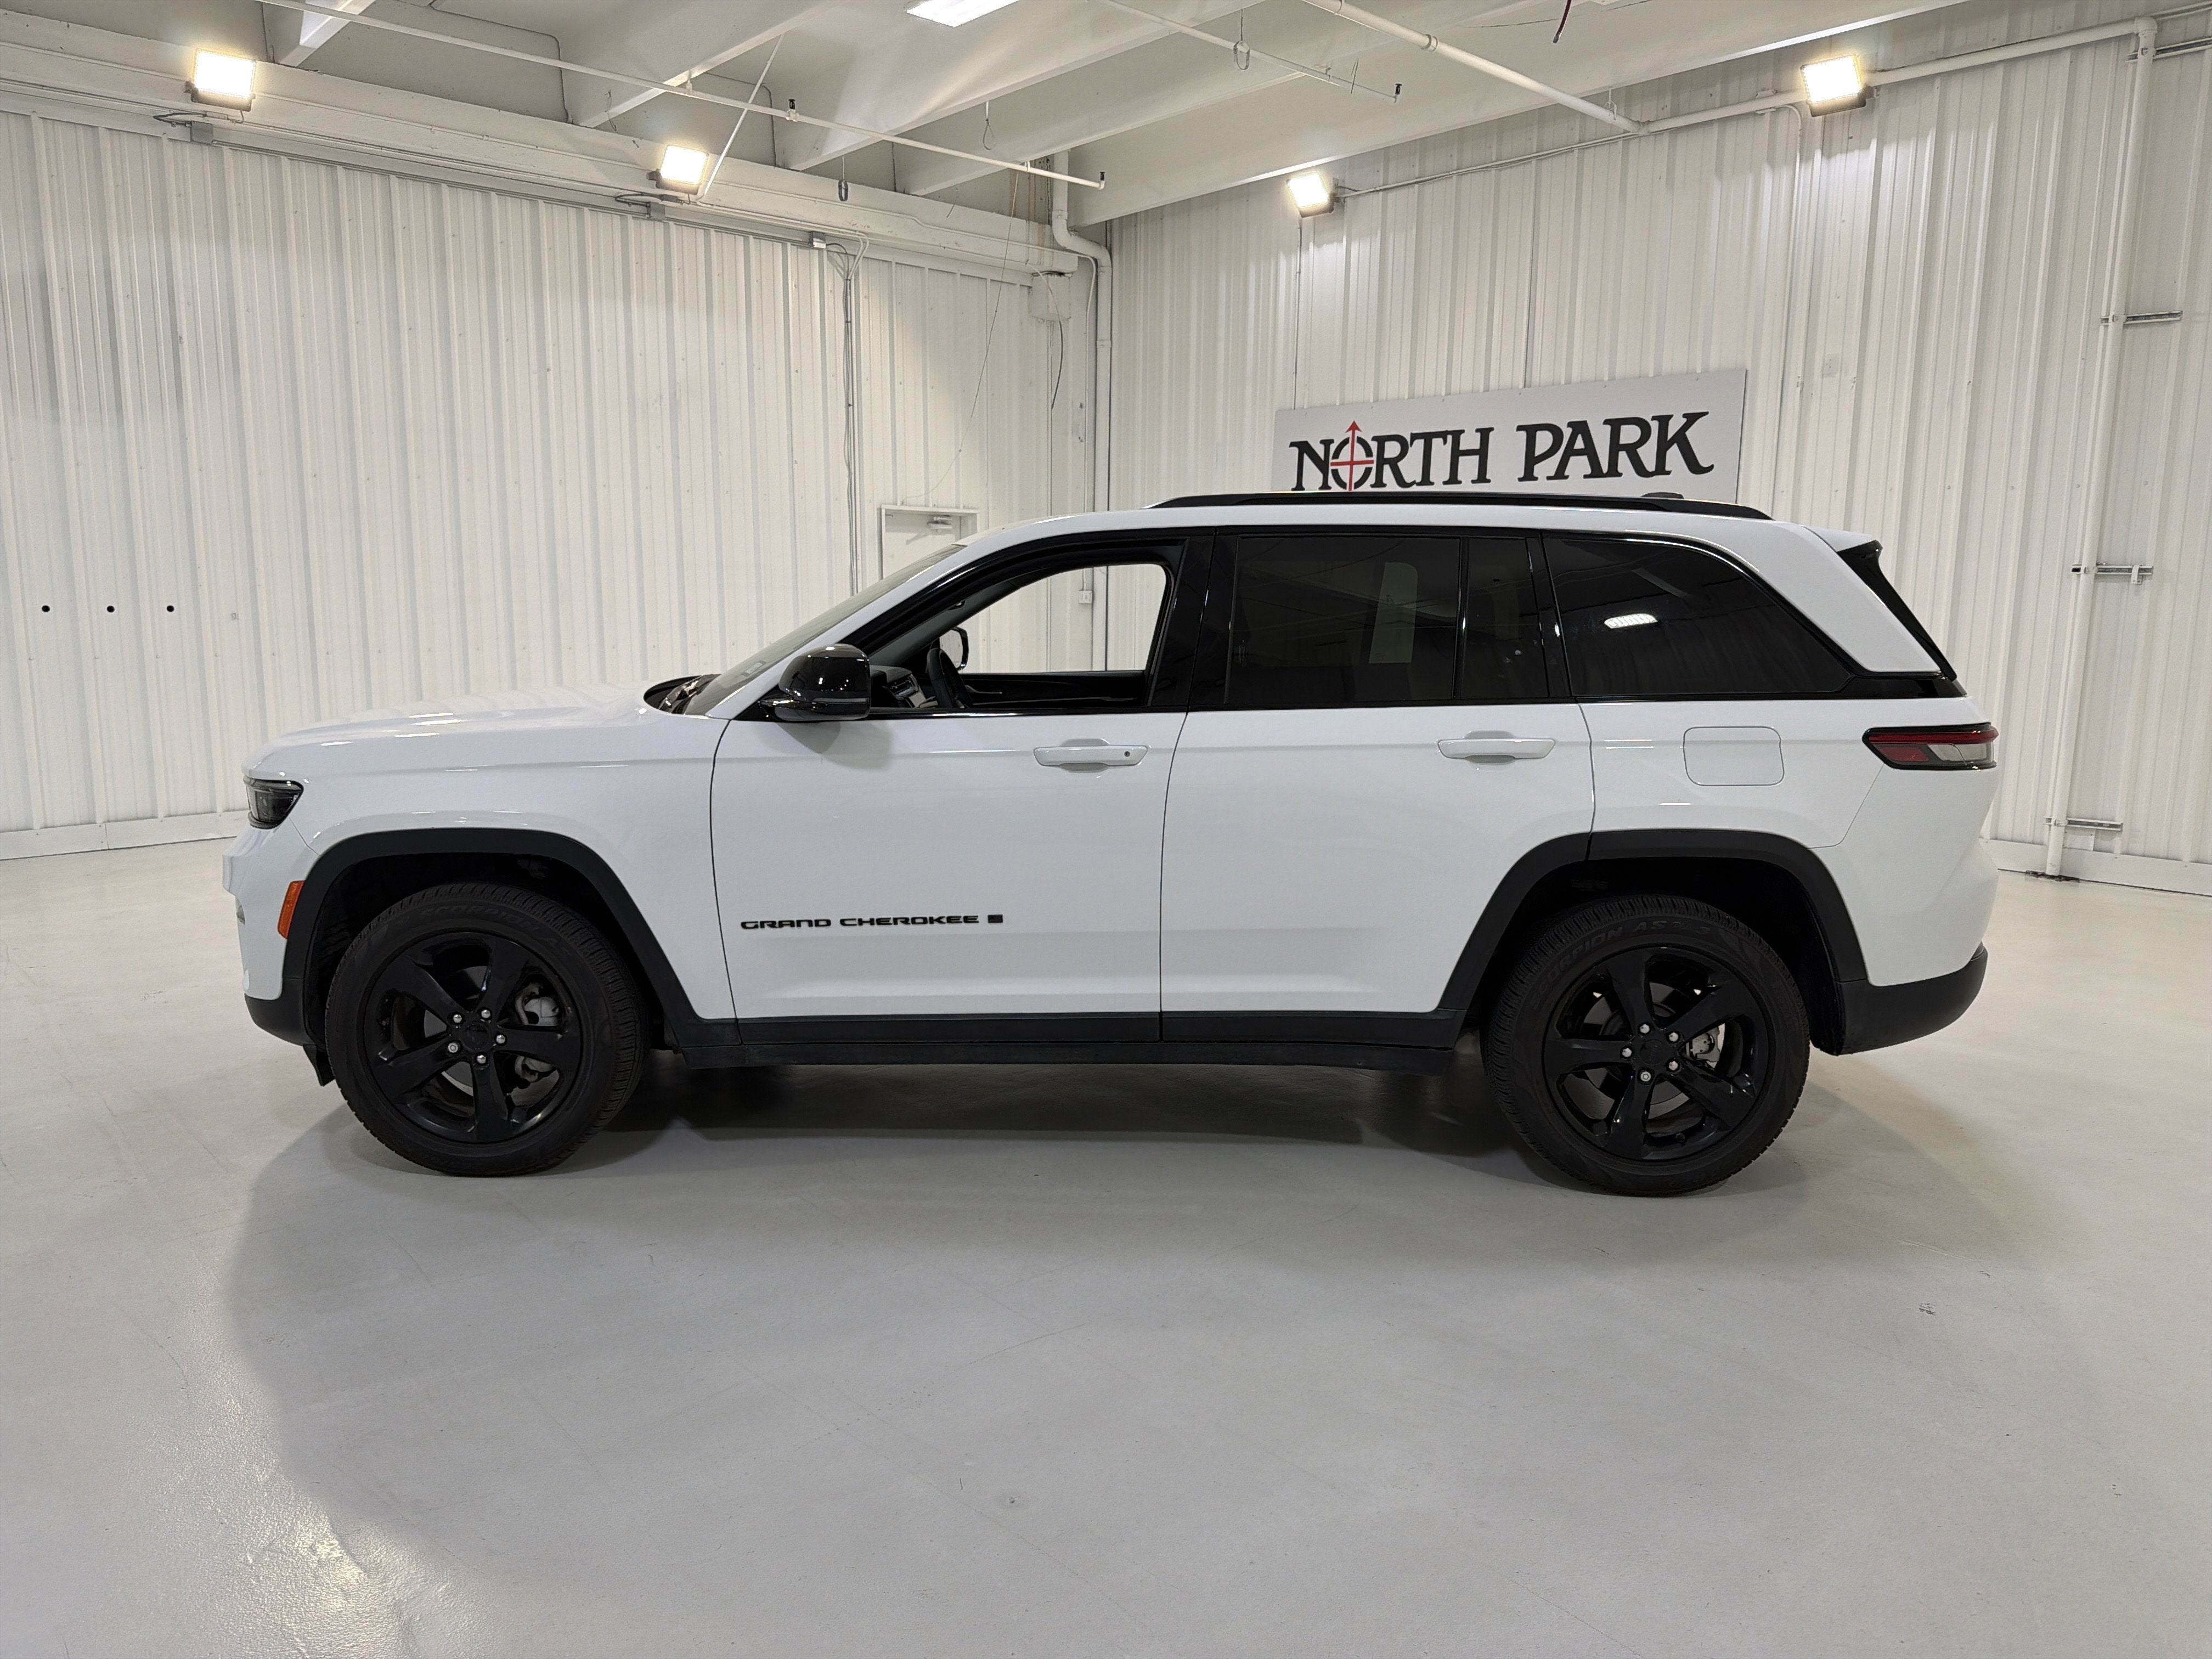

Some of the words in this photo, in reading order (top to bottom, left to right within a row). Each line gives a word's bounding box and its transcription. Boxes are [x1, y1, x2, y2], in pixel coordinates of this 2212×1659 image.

[1289, 427, 1494, 491] NORTH
[1516, 411, 1714, 482] PARK
[741, 919, 832, 930] GRAND
[839, 915, 979, 927] CHEROKEE
